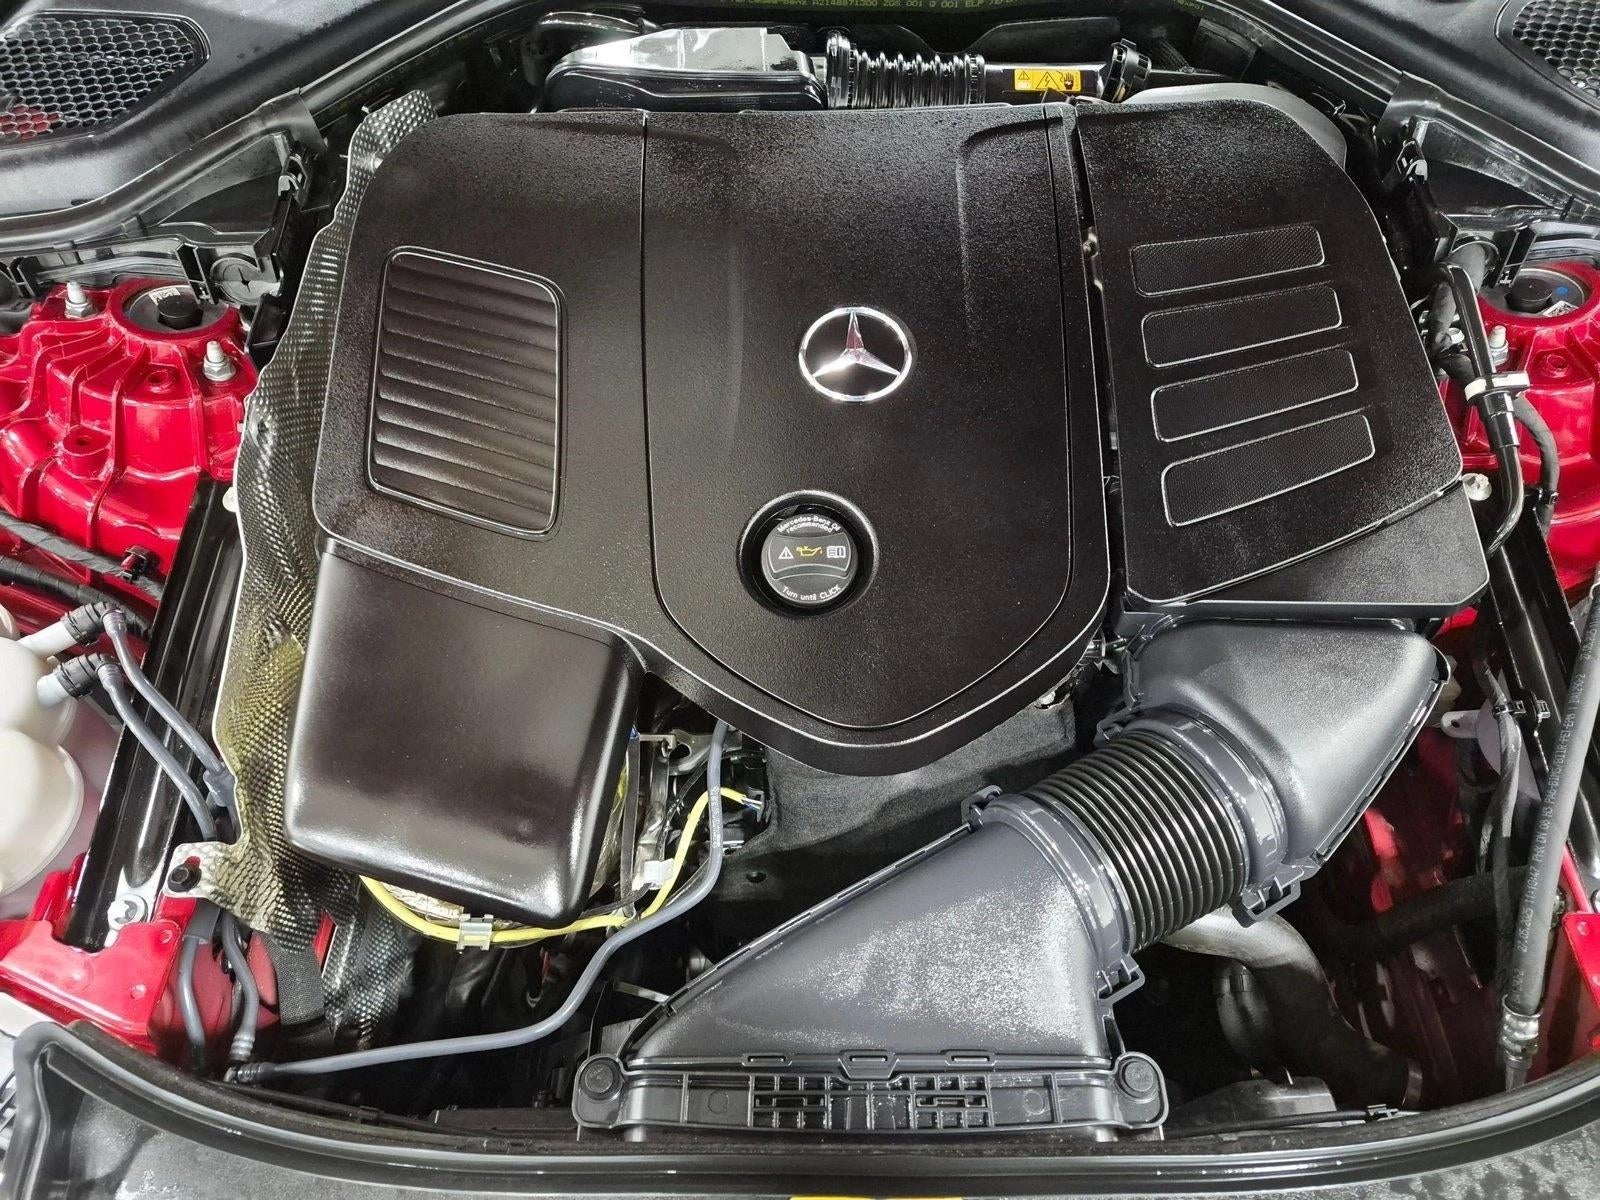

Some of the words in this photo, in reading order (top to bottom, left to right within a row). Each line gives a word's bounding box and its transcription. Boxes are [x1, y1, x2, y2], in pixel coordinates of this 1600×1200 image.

[777, 515, 831, 533] Mercedes-Benz
[831, 521, 841, 532] Oil
[786, 521, 833, 534] recommended
[782, 586, 798, 599] Turn
[800, 593, 817, 601] until
[819, 585, 841, 599] CLICK
